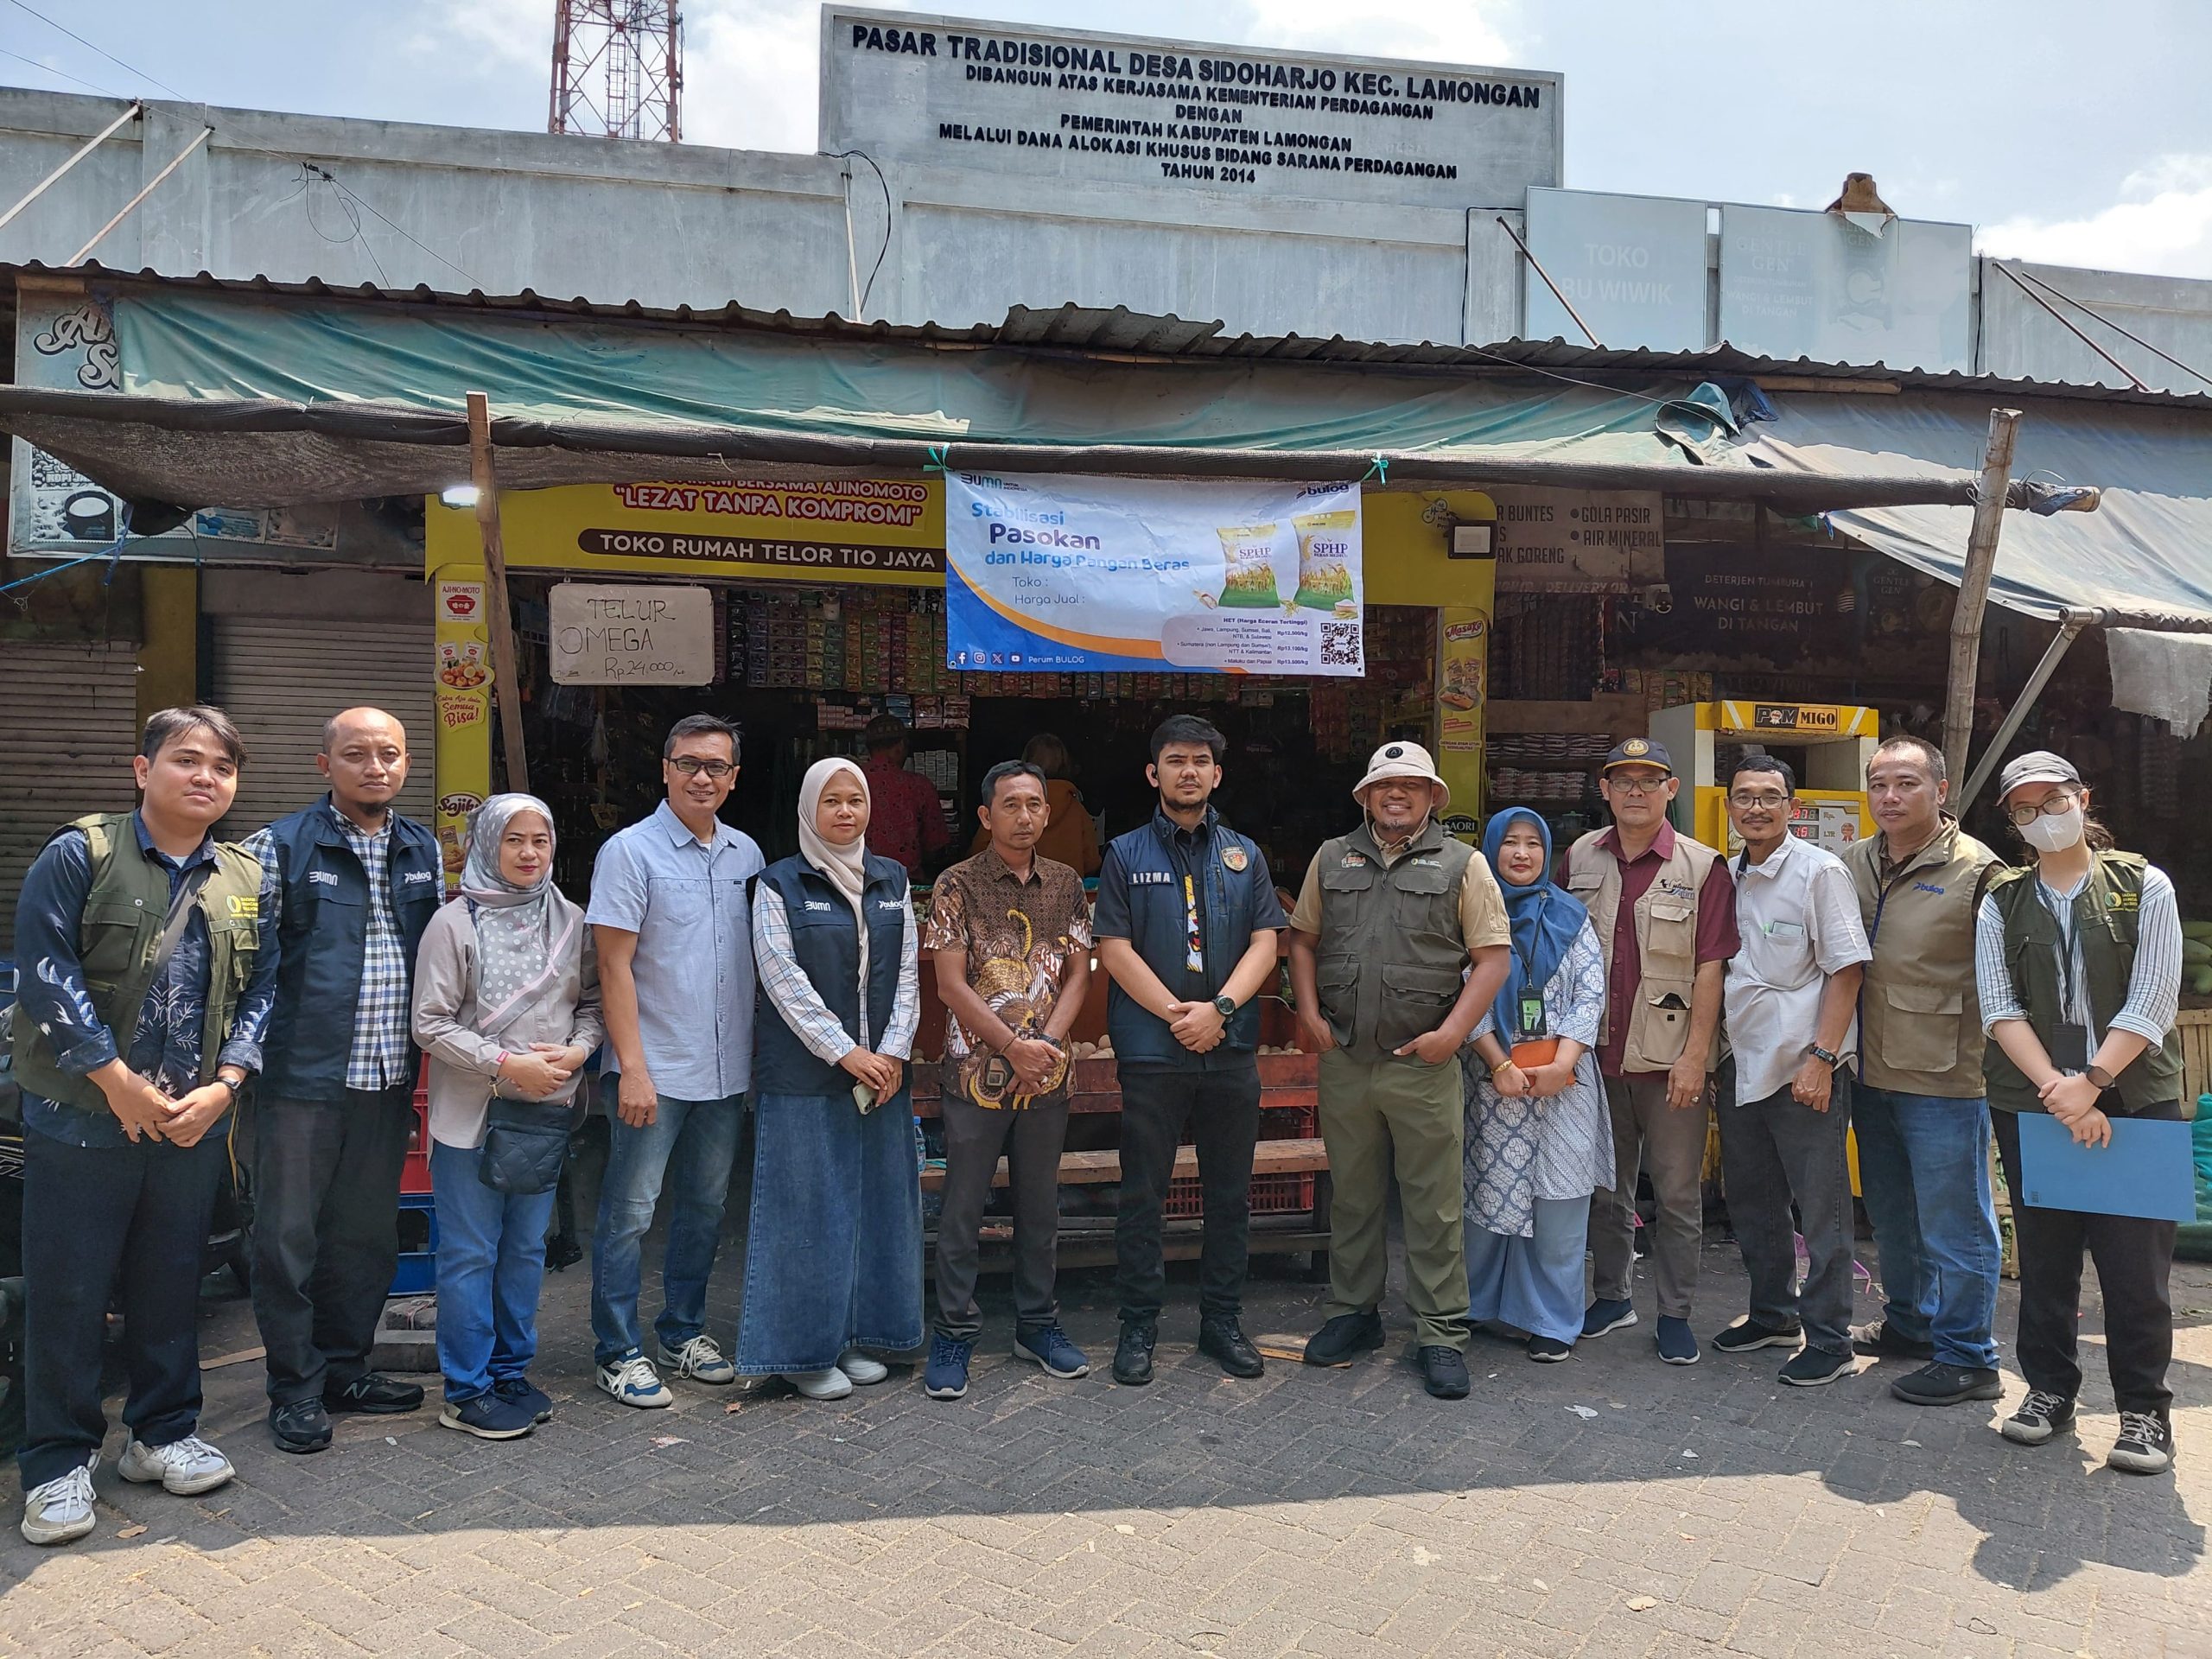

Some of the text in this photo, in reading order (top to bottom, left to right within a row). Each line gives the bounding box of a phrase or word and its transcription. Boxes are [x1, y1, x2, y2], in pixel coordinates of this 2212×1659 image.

[852, 25, 1540, 108] PASAR TRADISIONAL DESA SIDOHARJO KEC. LAMONGAN
[966, 65, 1433, 119] DIBANGUN ATAS KERJASAMA KEMENTERIAN PERDAGANGAN
[1175, 104, 1243, 124] DENGAN
[1061, 114, 1351, 151] PEMERINTAH KABUPATEN LAMONGAN
[939, 124, 1457, 180] MELALUI DANA ALOKASI KHUSUS BIDANG SARANA PERDAGANGAN
[1161, 162, 1255, 183] TAHUN 2014
[1735, 235, 1807, 256] GENTLE
[1584, 243, 1649, 269] TOKO
[1751, 256, 1790, 272] GEN
[1561, 277, 1673, 305] BU WIWIK
[1728, 290, 1760, 302] WANGI
[1773, 295, 1815, 306] LEMBUT
[1742, 306, 1797, 318] DI TANGAN
[823, 481, 926, 499] AJINOMOTO
[704, 492, 779, 514] TANPA
[971, 502, 1065, 526] Stabilisasi
[1508, 505, 1554, 522] BUNTES
[1616, 508, 1650, 524] PASIR
[988, 523, 1101, 550] Pasokan
[1583, 530, 1661, 548] AIR MINERAL
[600, 534, 935, 569] TOKO RUMAH TELOR TIO JAYA
[1239, 547, 1272, 558] SPHP
[1313, 543, 1349, 554] SPHP
[1516, 548, 1564, 564] GORENG
[985, 550, 1190, 572] dan Harga Pangan Beras
[1013, 576, 1042, 588] Toko
[1705, 574, 1756, 587] DETERJEN
[1014, 594, 1051, 607] Harga
[1054, 594, 1079, 604] Jual
[1694, 596, 1745, 612] WANGI
[1764, 598, 1823, 616] LEMBUT
[587, 599, 677, 622] TELUR
[1718, 617, 1798, 632] DI TANGAN
[558, 627, 654, 654] OMEGA
[1028, 656, 1085, 664] Perum BULOG
[442, 702, 474, 713] Semua
[444, 707, 479, 728] Bisa!
[1801, 712, 1835, 725] MIGO
[409, 871, 432, 883] bulog
[1133, 872, 1171, 884] LIZMA
[1921, 883, 1944, 895] bulog
